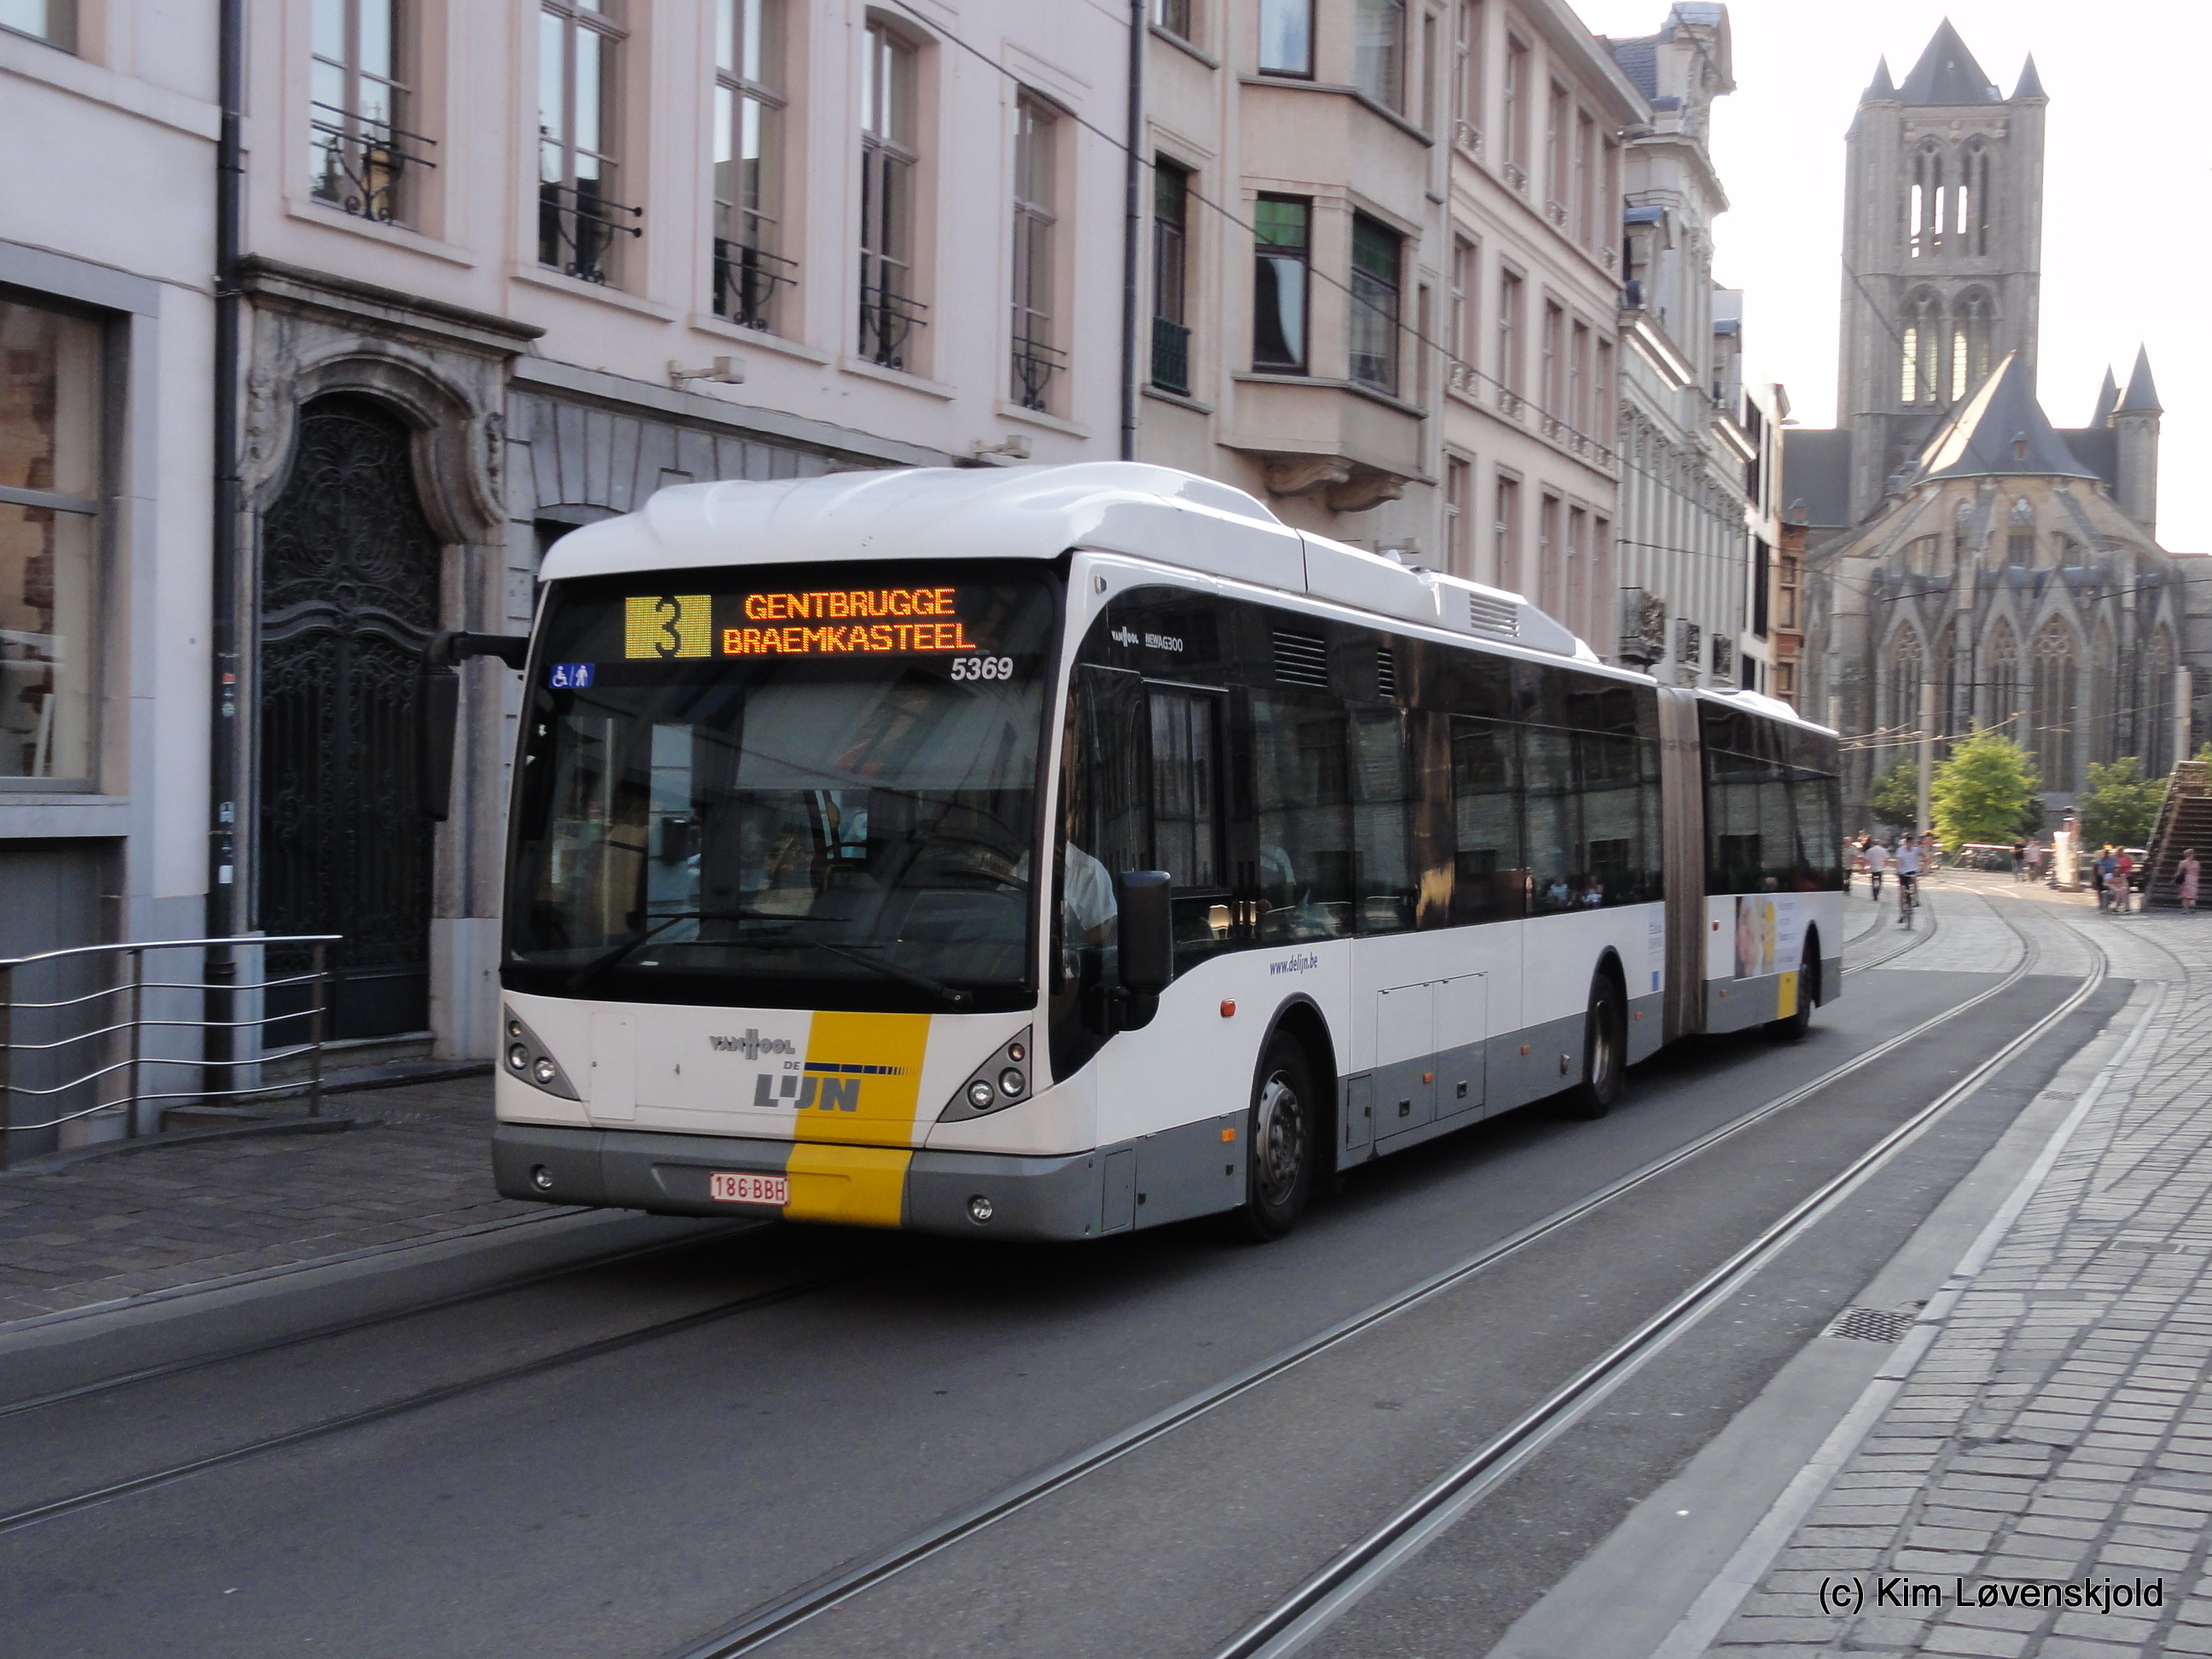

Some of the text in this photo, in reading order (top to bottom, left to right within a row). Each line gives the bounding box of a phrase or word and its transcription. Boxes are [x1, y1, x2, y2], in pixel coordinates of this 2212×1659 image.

[745, 588, 956, 619] GENTBRUGGE
[654, 596, 681, 657] 3
[723, 622, 976, 655] BRAEMKASTEEL
[951, 657, 1014, 681] 5369
[1269, 952, 1318, 975] www.delijn.be
[783, 1061, 801, 1070] DE
[753, 1074, 861, 1112] LIJN
